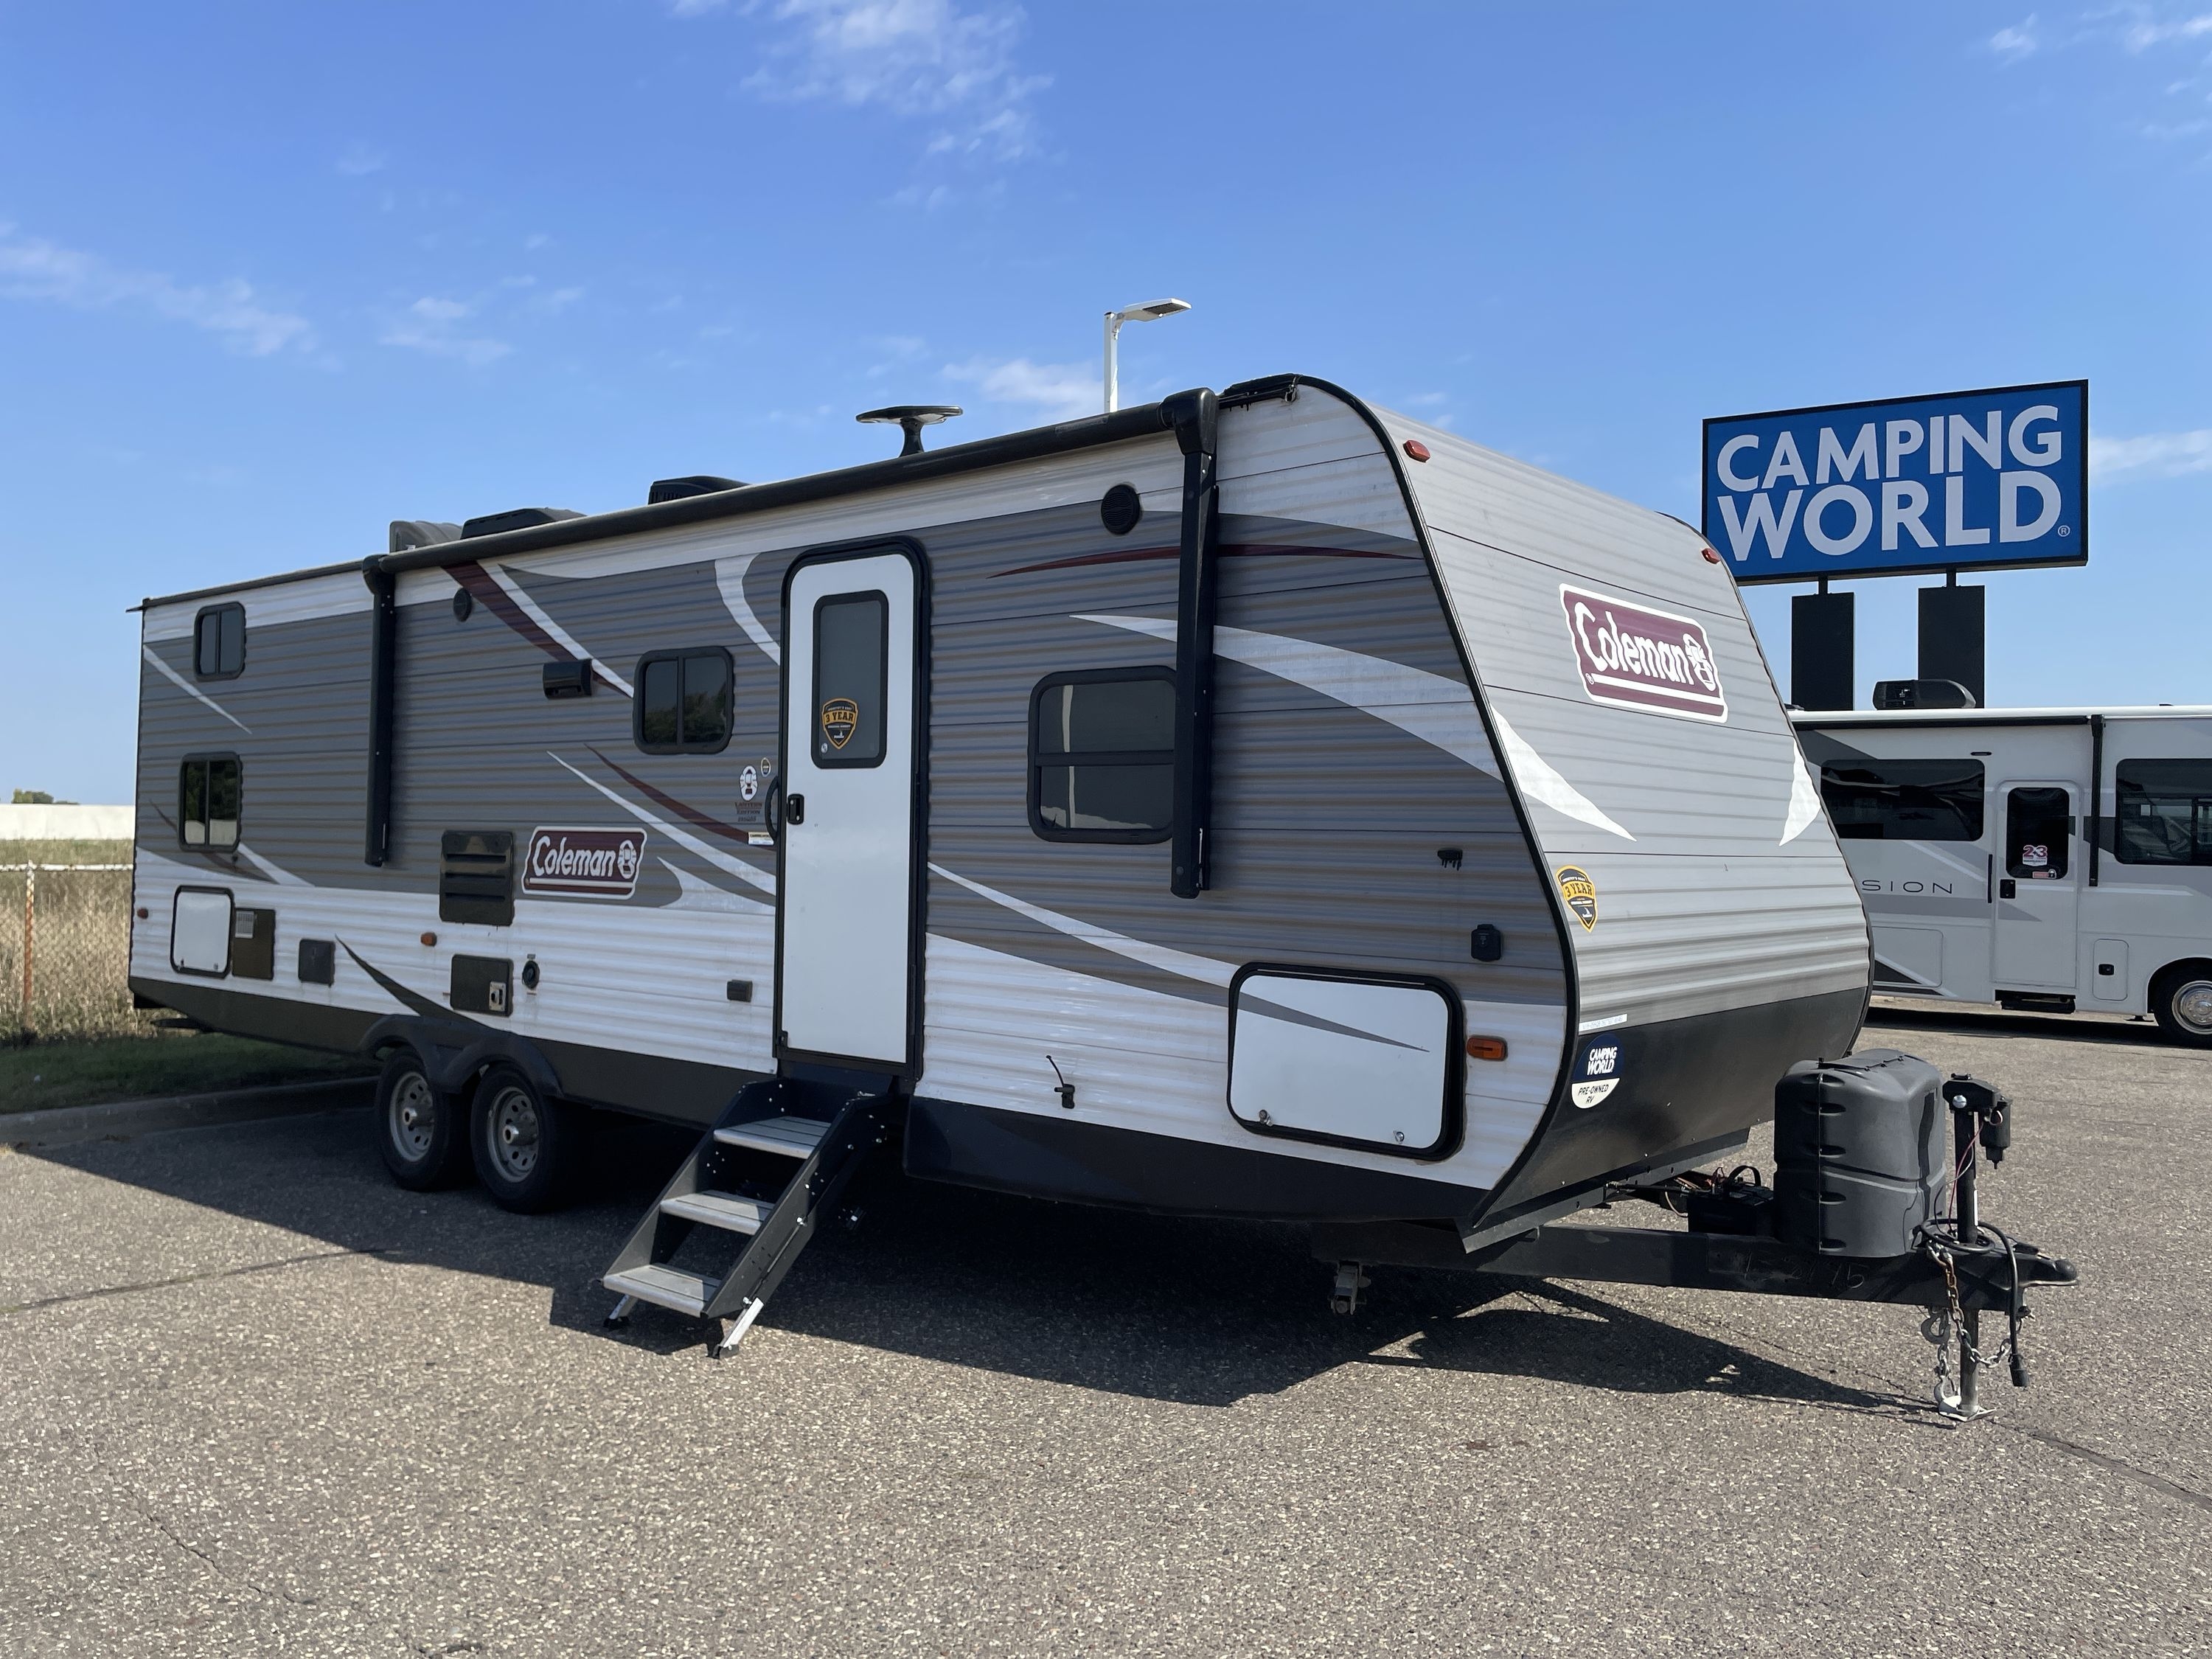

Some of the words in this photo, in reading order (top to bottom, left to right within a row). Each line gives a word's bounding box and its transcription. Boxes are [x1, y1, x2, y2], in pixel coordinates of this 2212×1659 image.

[1717, 405, 2062, 493] CAMPING
[1717, 470, 2062, 562] WORLD
[1574, 602, 1694, 686] Coleman
[825, 714, 830, 723] 3
[832, 712, 854, 722] YEAR
[532, 835, 616, 877] Coleman
[1565, 886, 1571, 897] 3
[1570, 883, 1593, 896] YEAR
[1589, 1046, 1618, 1062] CAMPING
[1587, 1059, 1615, 1076] WORLD
[1578, 1084, 1610, 1096] PRE-OWNED
[1586, 1096, 1595, 1104] RV
